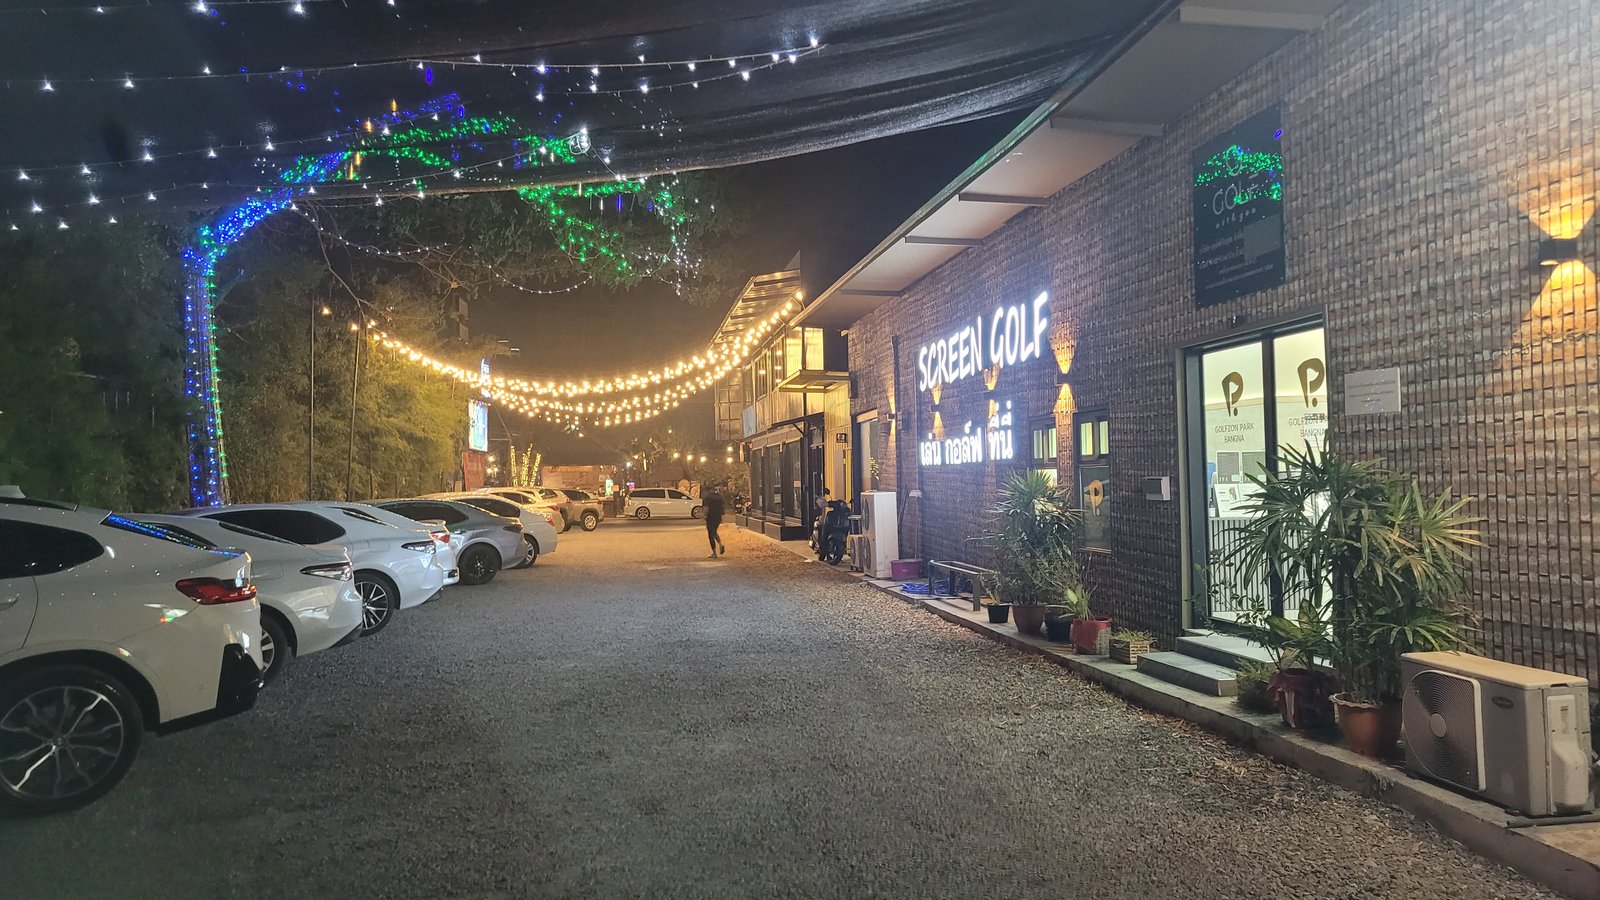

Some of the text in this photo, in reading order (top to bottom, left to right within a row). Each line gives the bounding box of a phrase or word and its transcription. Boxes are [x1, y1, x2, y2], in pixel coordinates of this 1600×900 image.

[918, 290, 1048, 393] SCREEN GOLF
[1214, 422, 1255, 434] GOLFZON PARK
[1224, 434, 1245, 444] BANGNA
[920, 432, 942, 466] เล่น
[944, 420, 983, 465] กอล์ฟ
